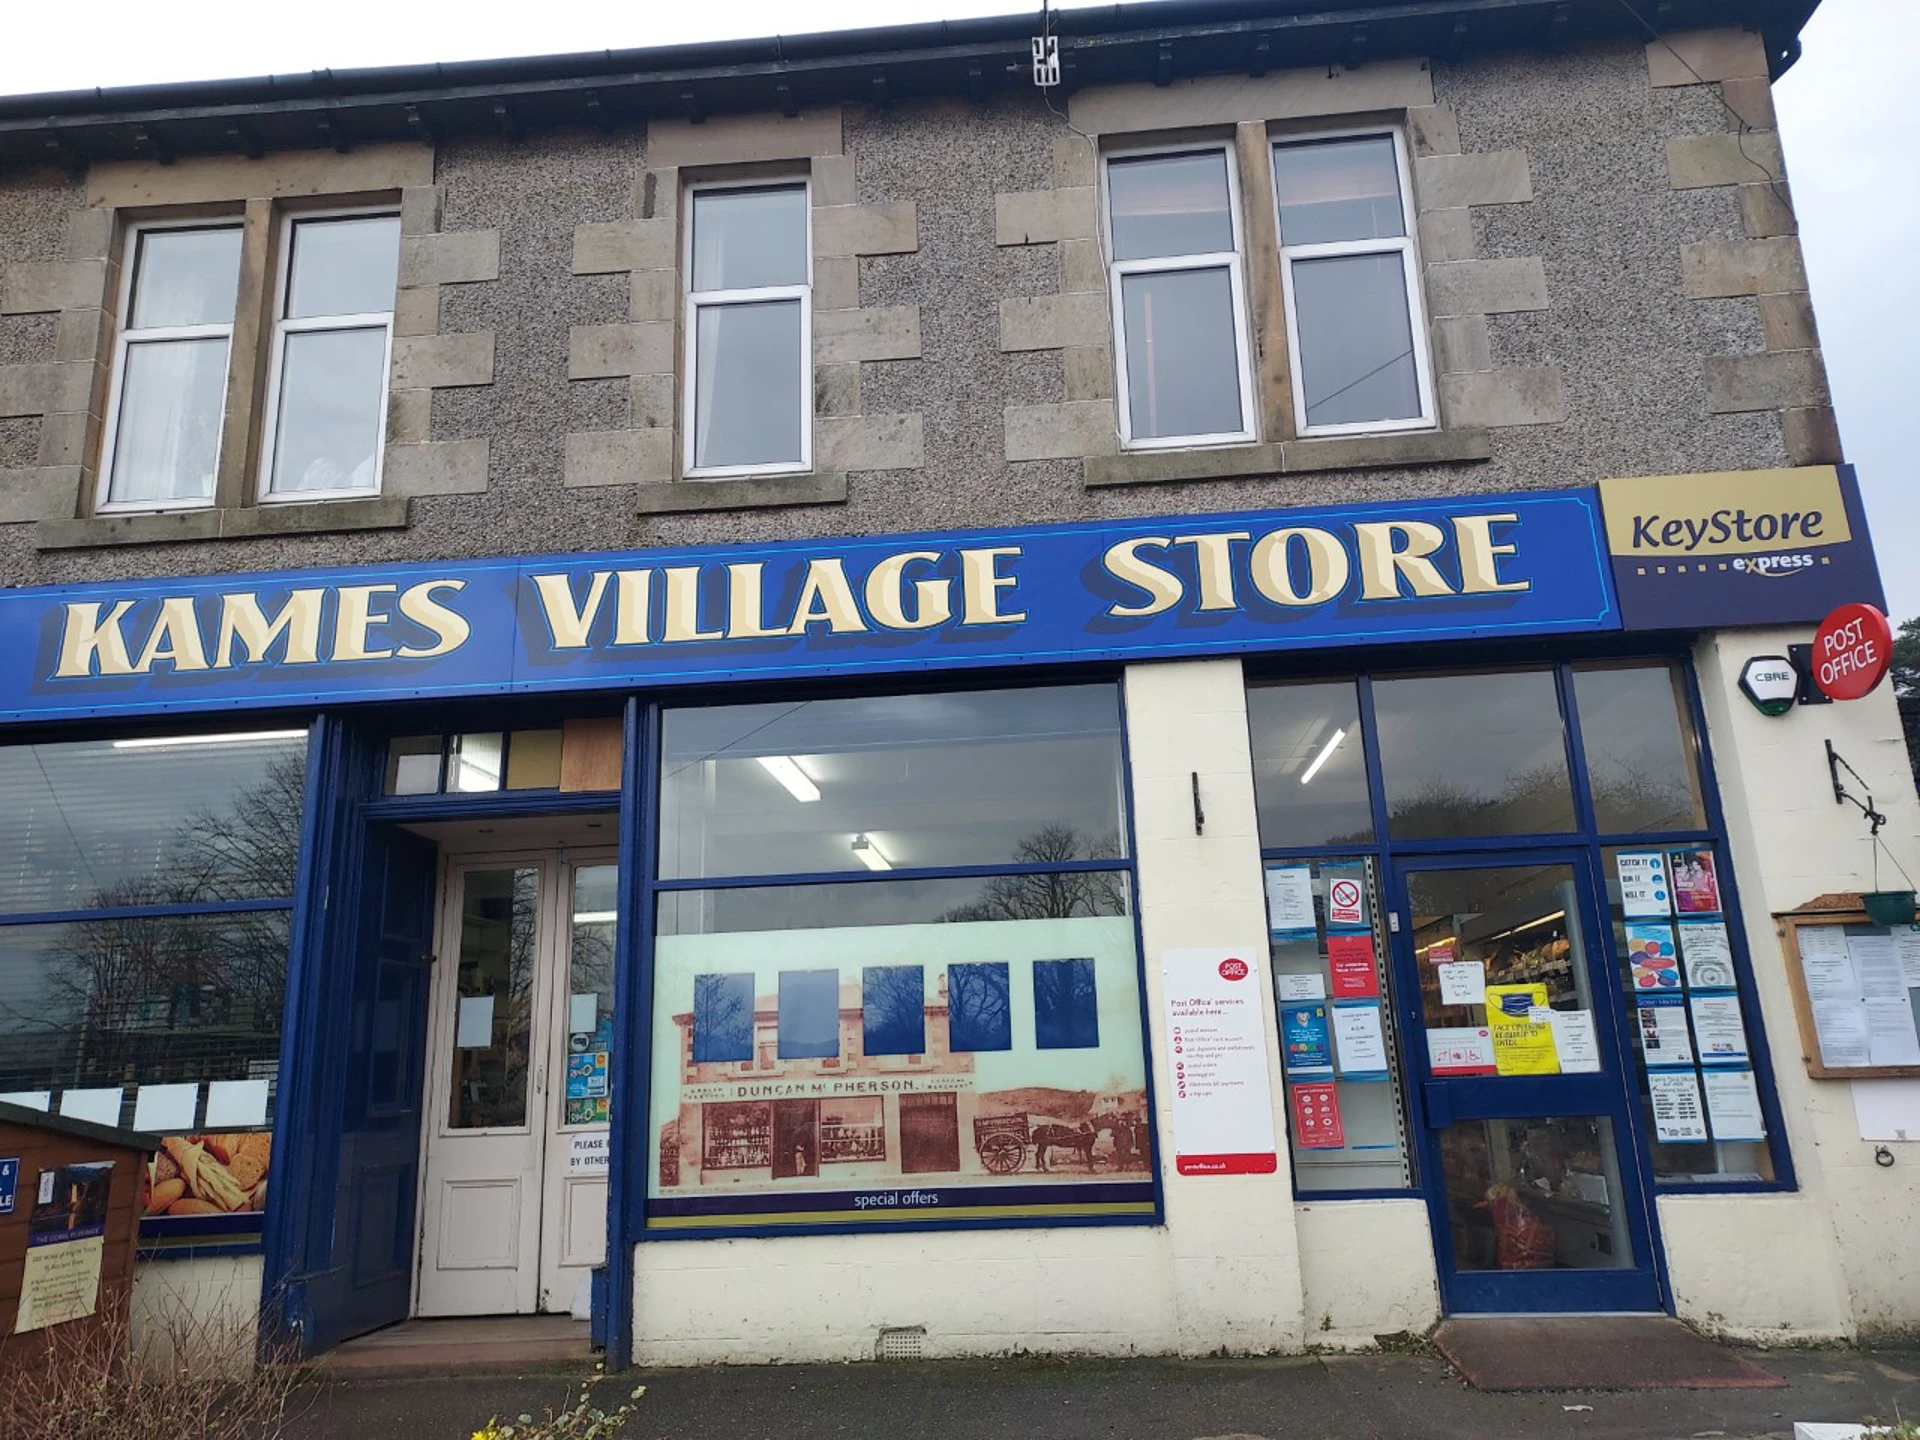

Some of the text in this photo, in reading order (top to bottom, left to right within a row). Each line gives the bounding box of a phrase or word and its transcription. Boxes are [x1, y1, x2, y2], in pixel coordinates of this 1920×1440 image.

[1633, 510, 1823, 551] KeyStore
[1733, 554, 1814, 574] express
[50, 512, 1532, 680] KAMES VILLAGE STORE
[1823, 617, 1863, 657] POST
[1820, 640, 1877, 685] OFFICE
[1221, 968, 1246, 976] OFFICE
[737, 1084, 805, 1097] DUNCAN
[574, 1140, 603, 1149] PLEASE
[570, 1157, 581, 1167] BY
[854, 1190, 939, 1209] special offers
